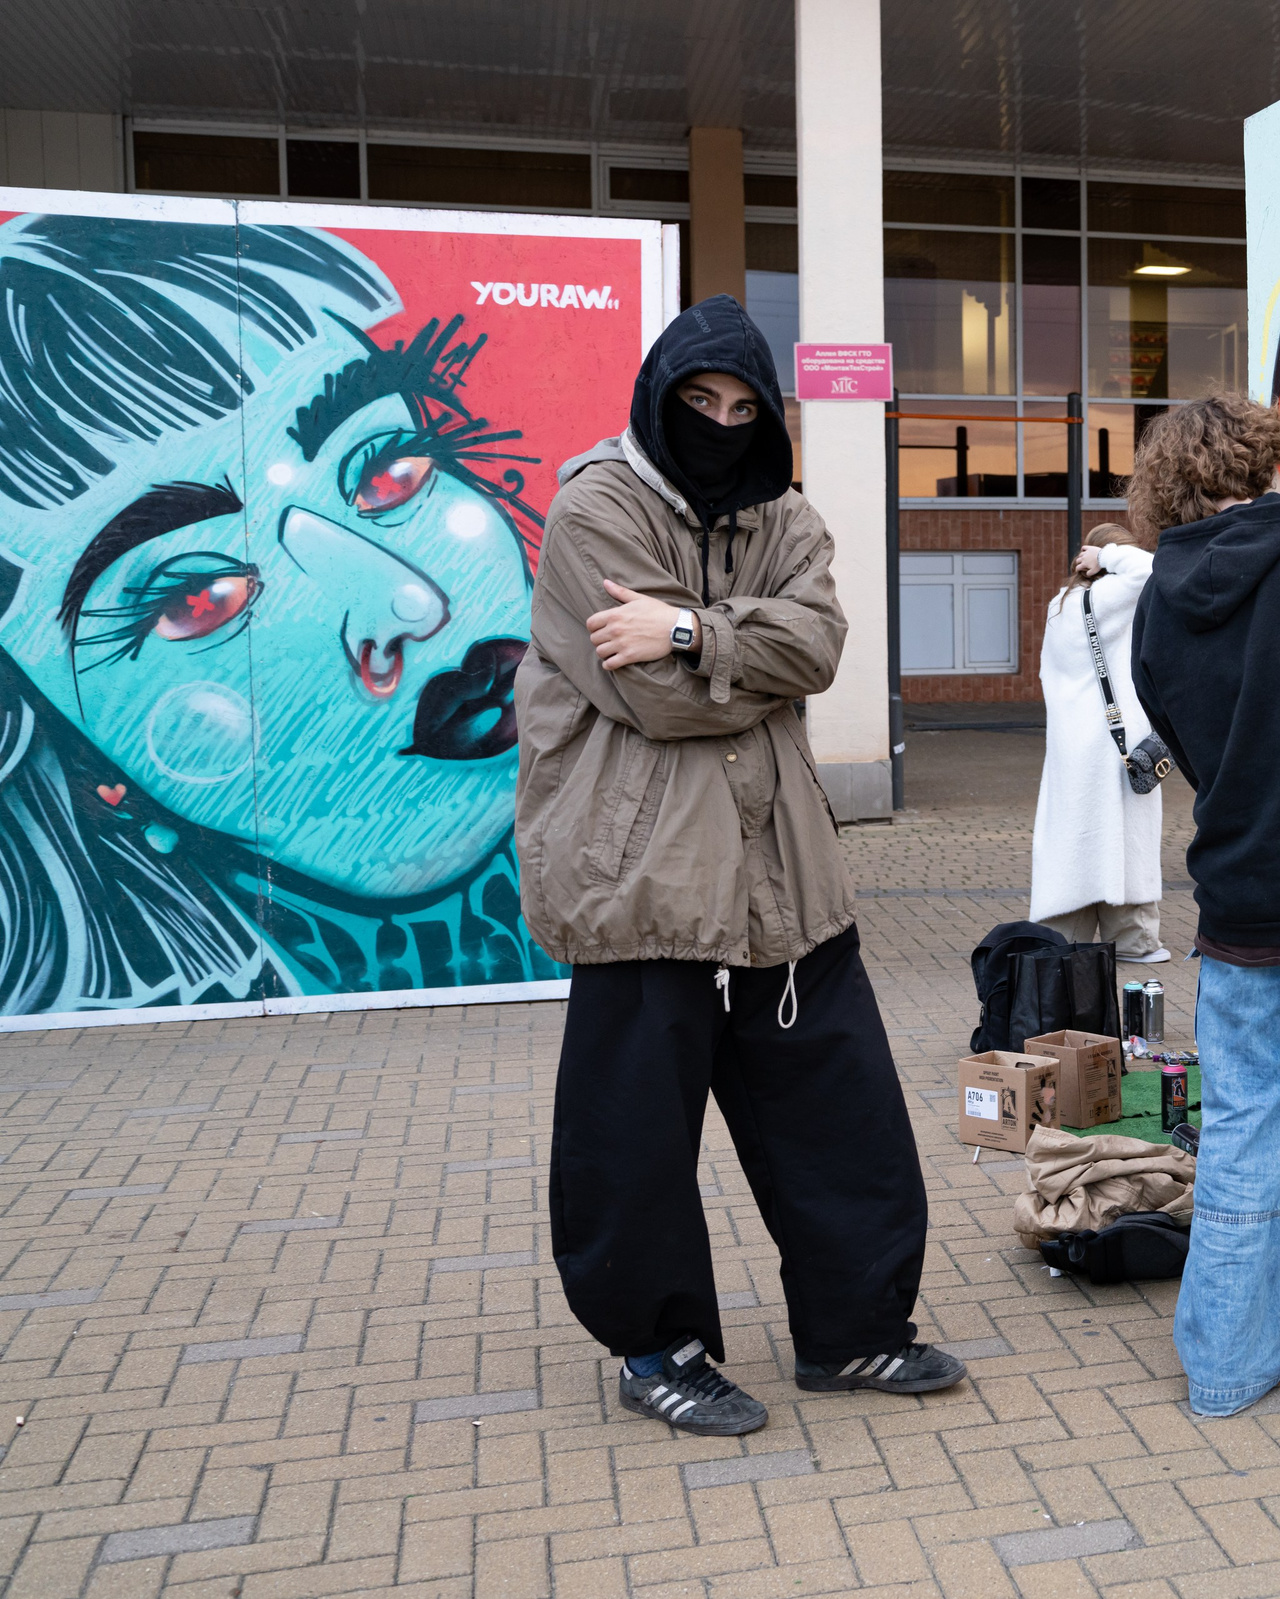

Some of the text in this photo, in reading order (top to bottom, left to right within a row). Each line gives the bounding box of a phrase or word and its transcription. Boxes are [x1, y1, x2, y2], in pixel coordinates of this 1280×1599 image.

[1085, 613, 1106, 678] CHRISTIAN DIOR
[968, 1091, 984, 1102] A706
